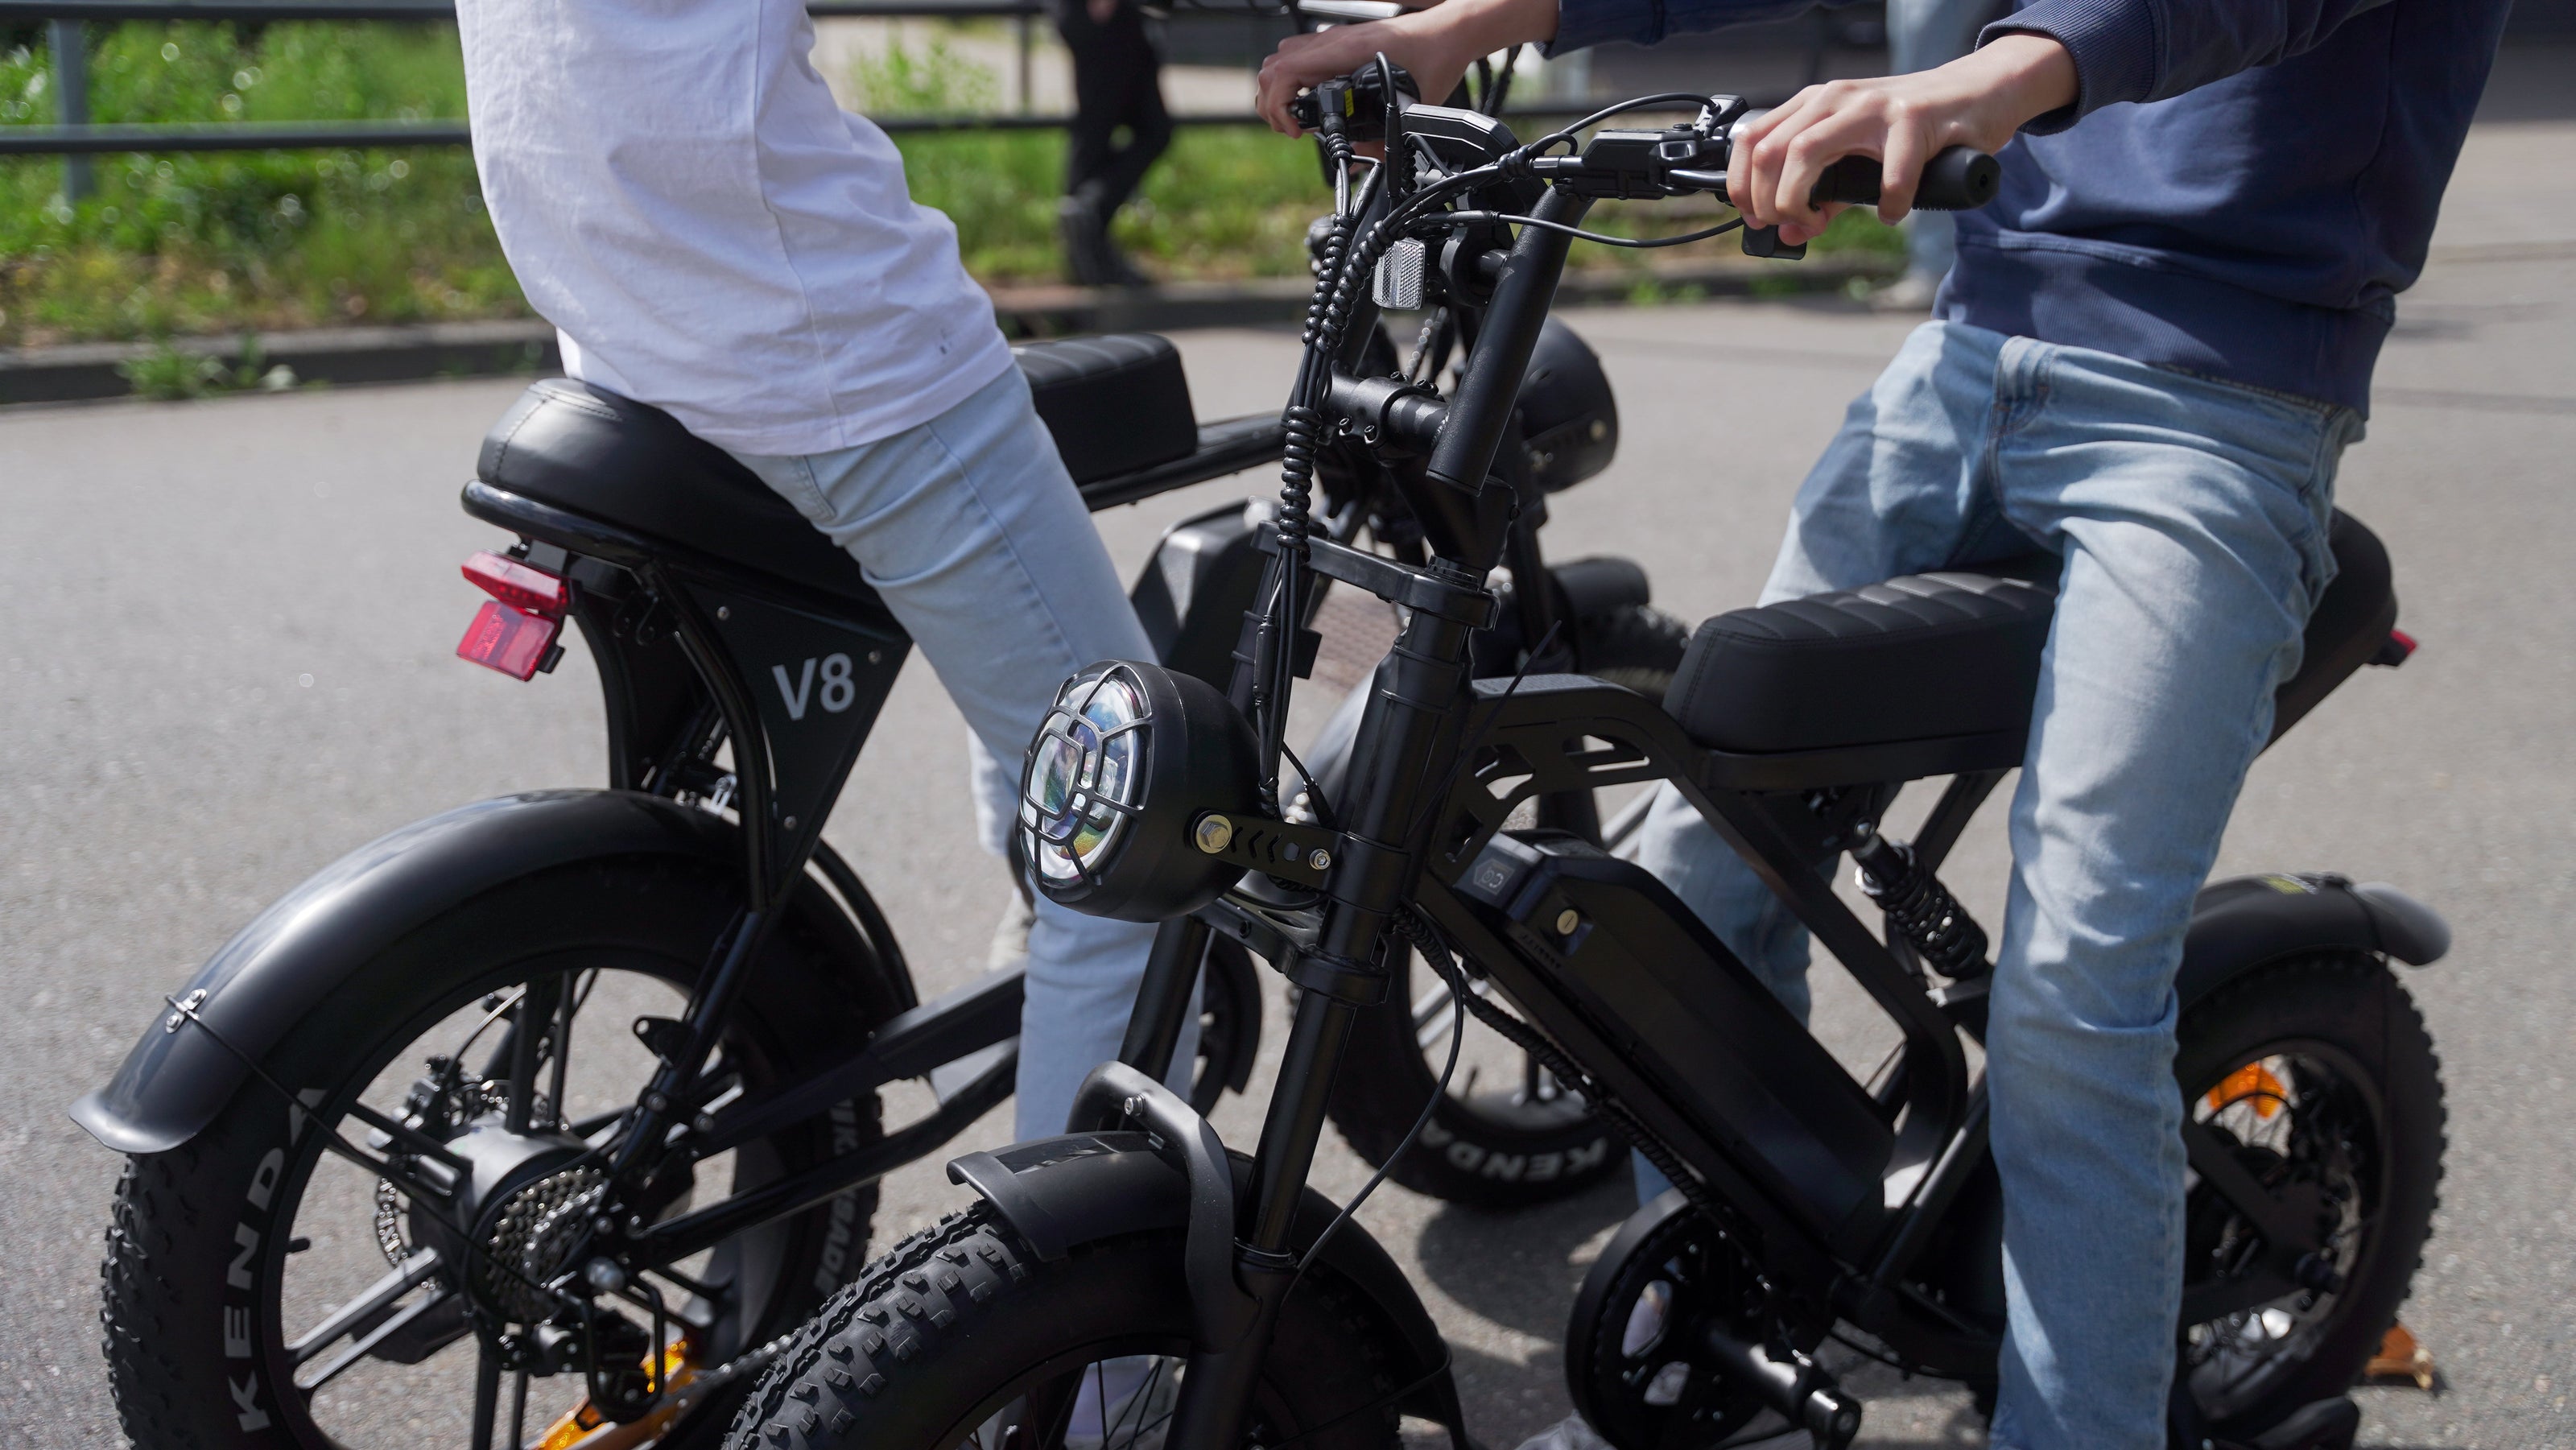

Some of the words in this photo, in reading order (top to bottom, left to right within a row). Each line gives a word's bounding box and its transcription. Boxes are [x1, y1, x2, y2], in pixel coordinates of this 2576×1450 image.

[772, 652, 856, 721] V8
[1418, 1117, 1609, 1183] KENDA
[223, 1088, 328, 1433] KENDA
